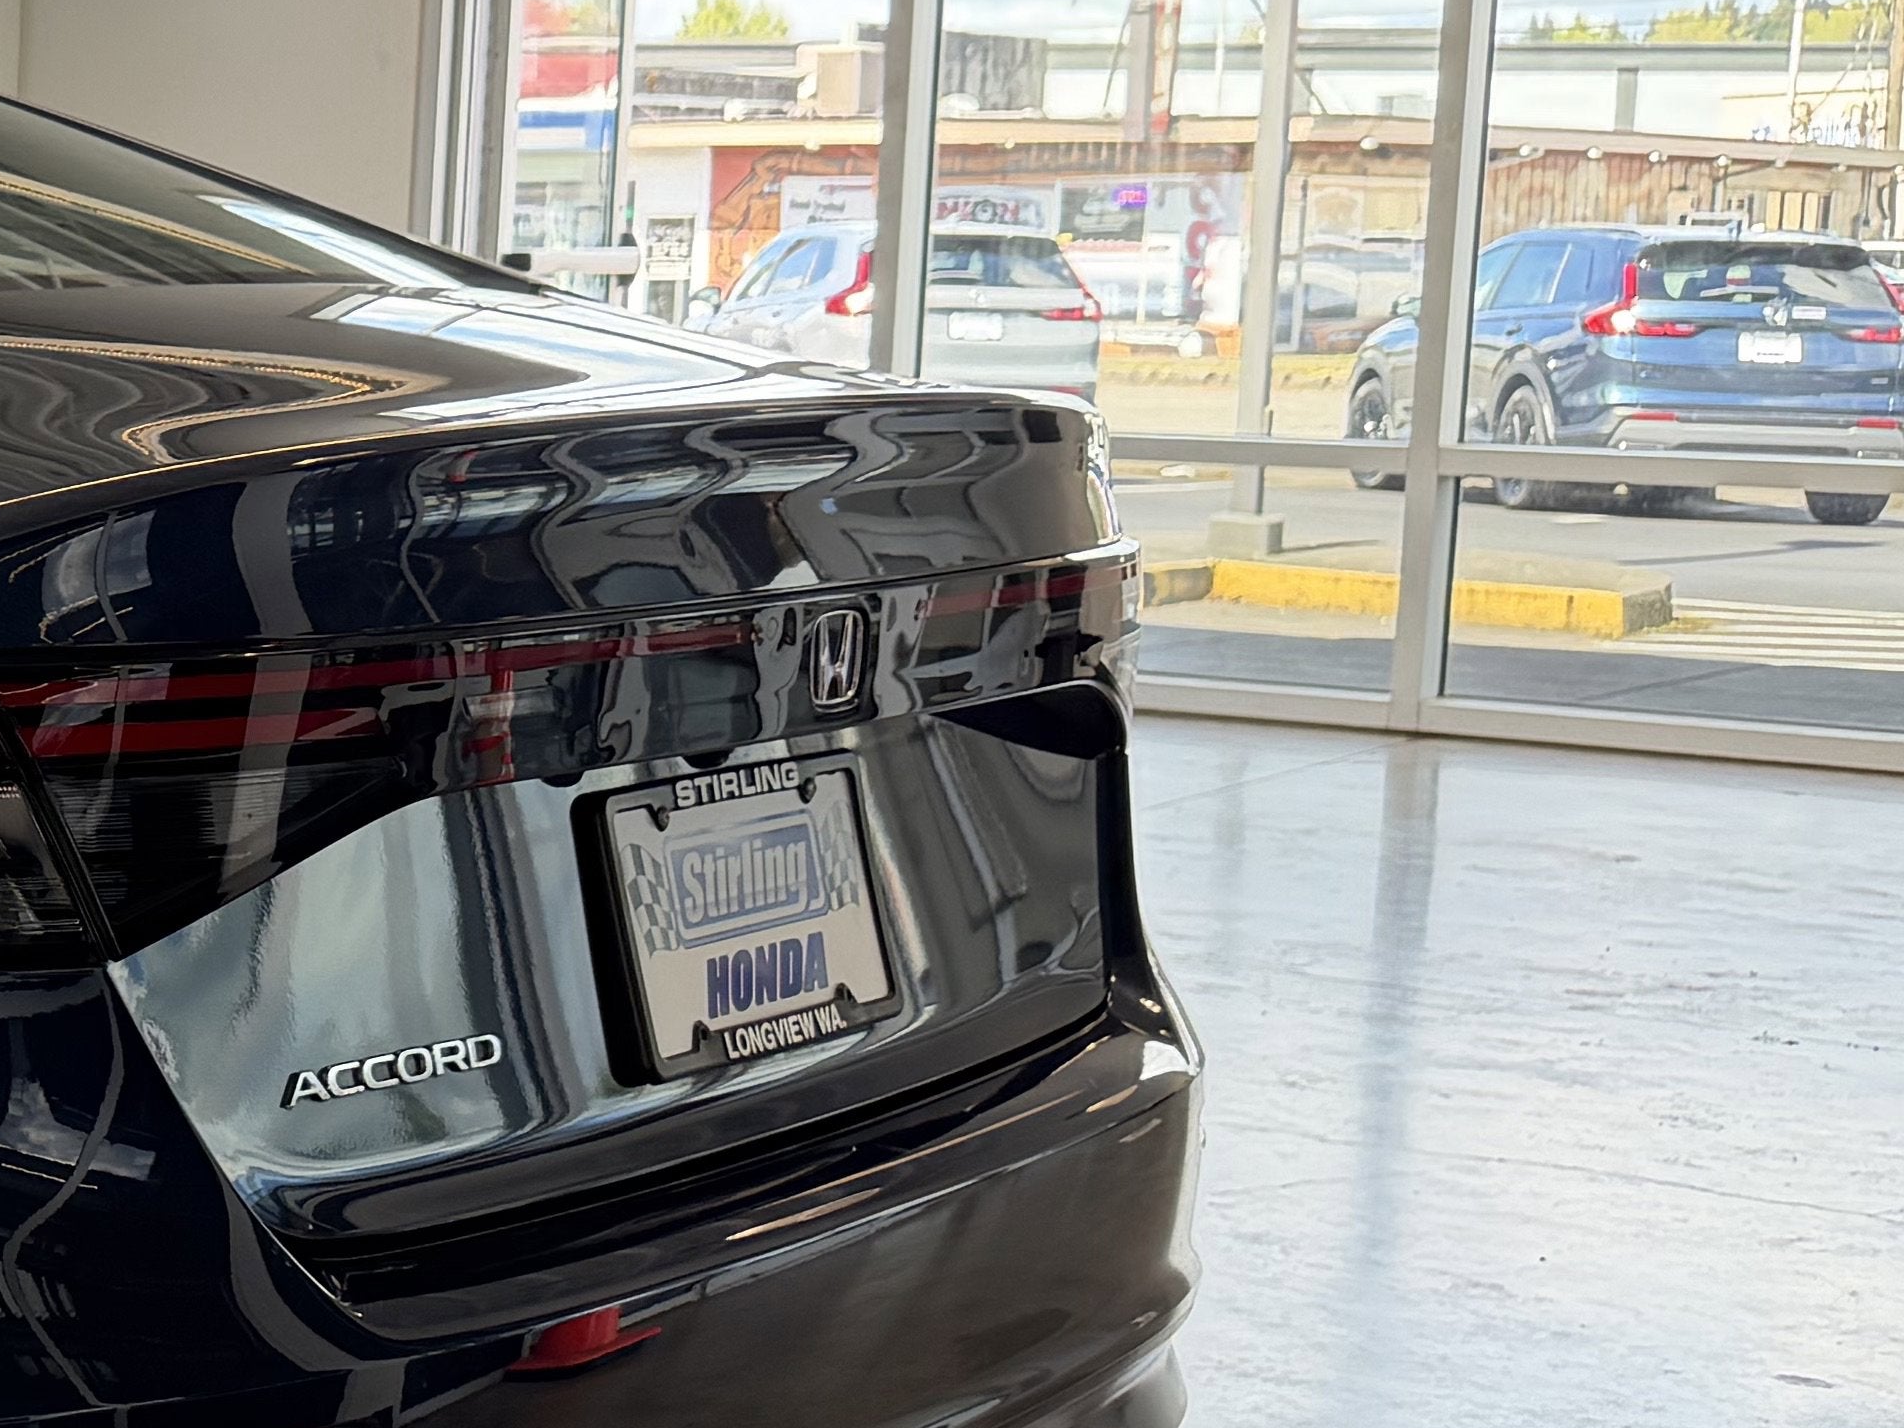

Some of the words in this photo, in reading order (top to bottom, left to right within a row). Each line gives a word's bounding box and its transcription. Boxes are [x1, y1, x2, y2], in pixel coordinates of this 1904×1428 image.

[675, 762, 799, 808] STIRLING
[682, 838, 808, 923] Stirling
[706, 931, 829, 1020] HONDA
[282, 1033, 502, 1109] ACCORD
[723, 1011, 816, 1060] LONGVIEW
